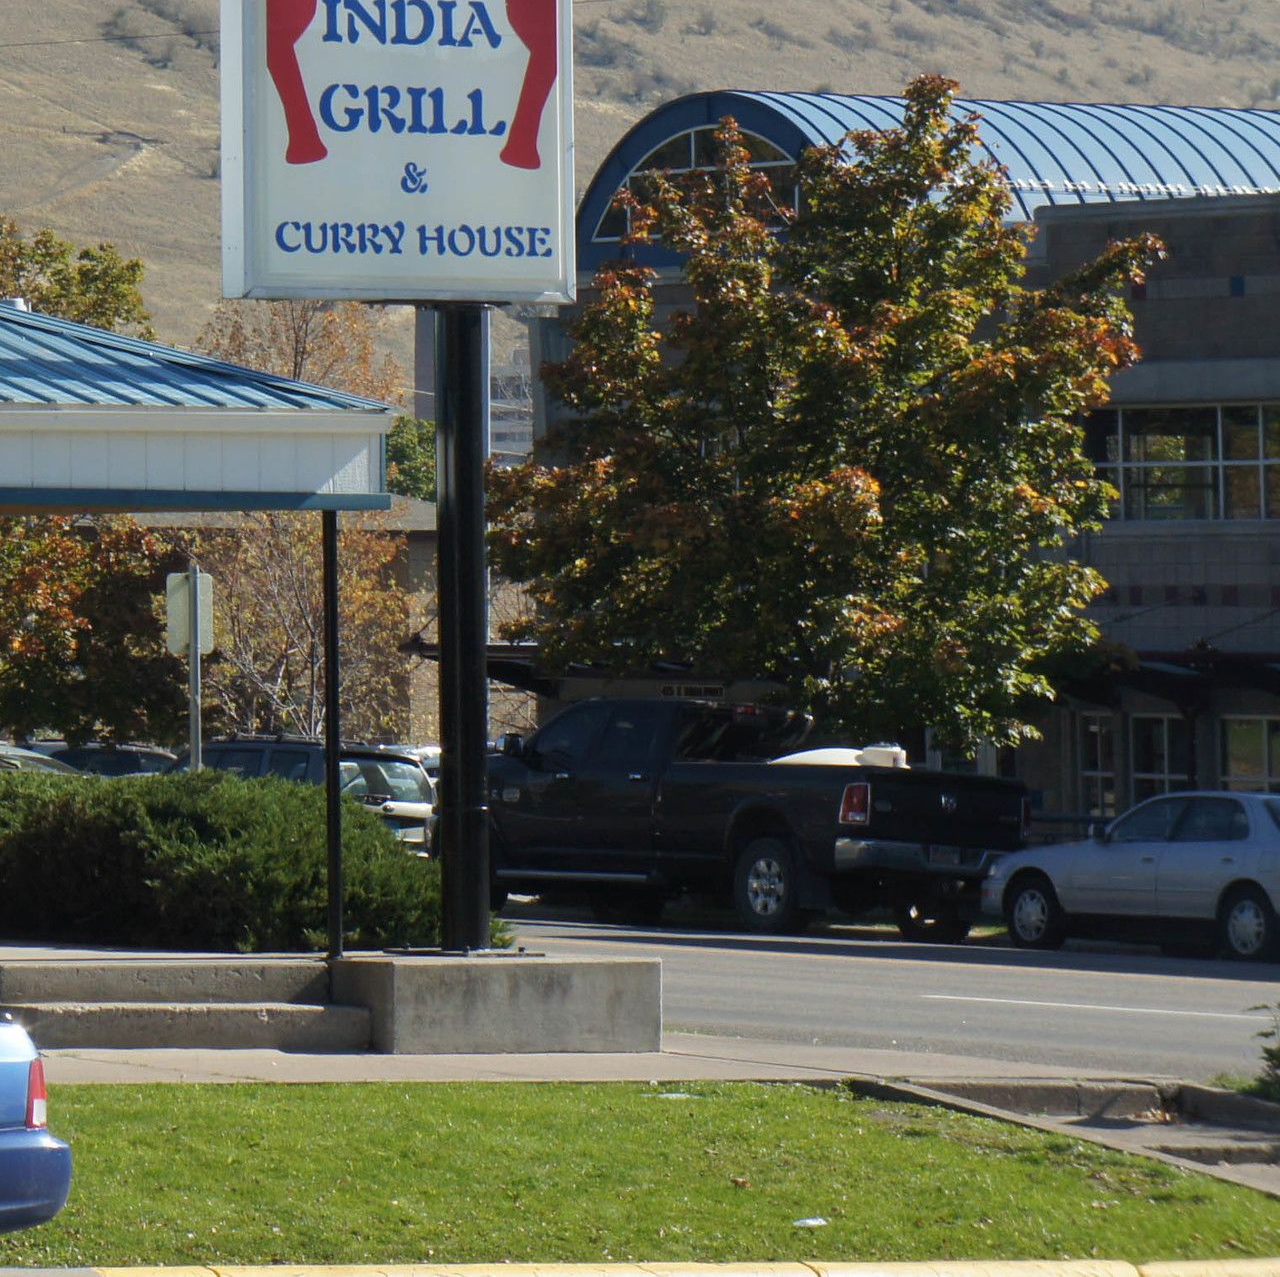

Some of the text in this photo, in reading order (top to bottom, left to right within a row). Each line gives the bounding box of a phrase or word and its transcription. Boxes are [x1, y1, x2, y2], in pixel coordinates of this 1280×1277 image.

[319, 83, 507, 136] GRILL
[399, 162, 428, 194] &
[275, 221, 552, 258] CURRY HOUSE
